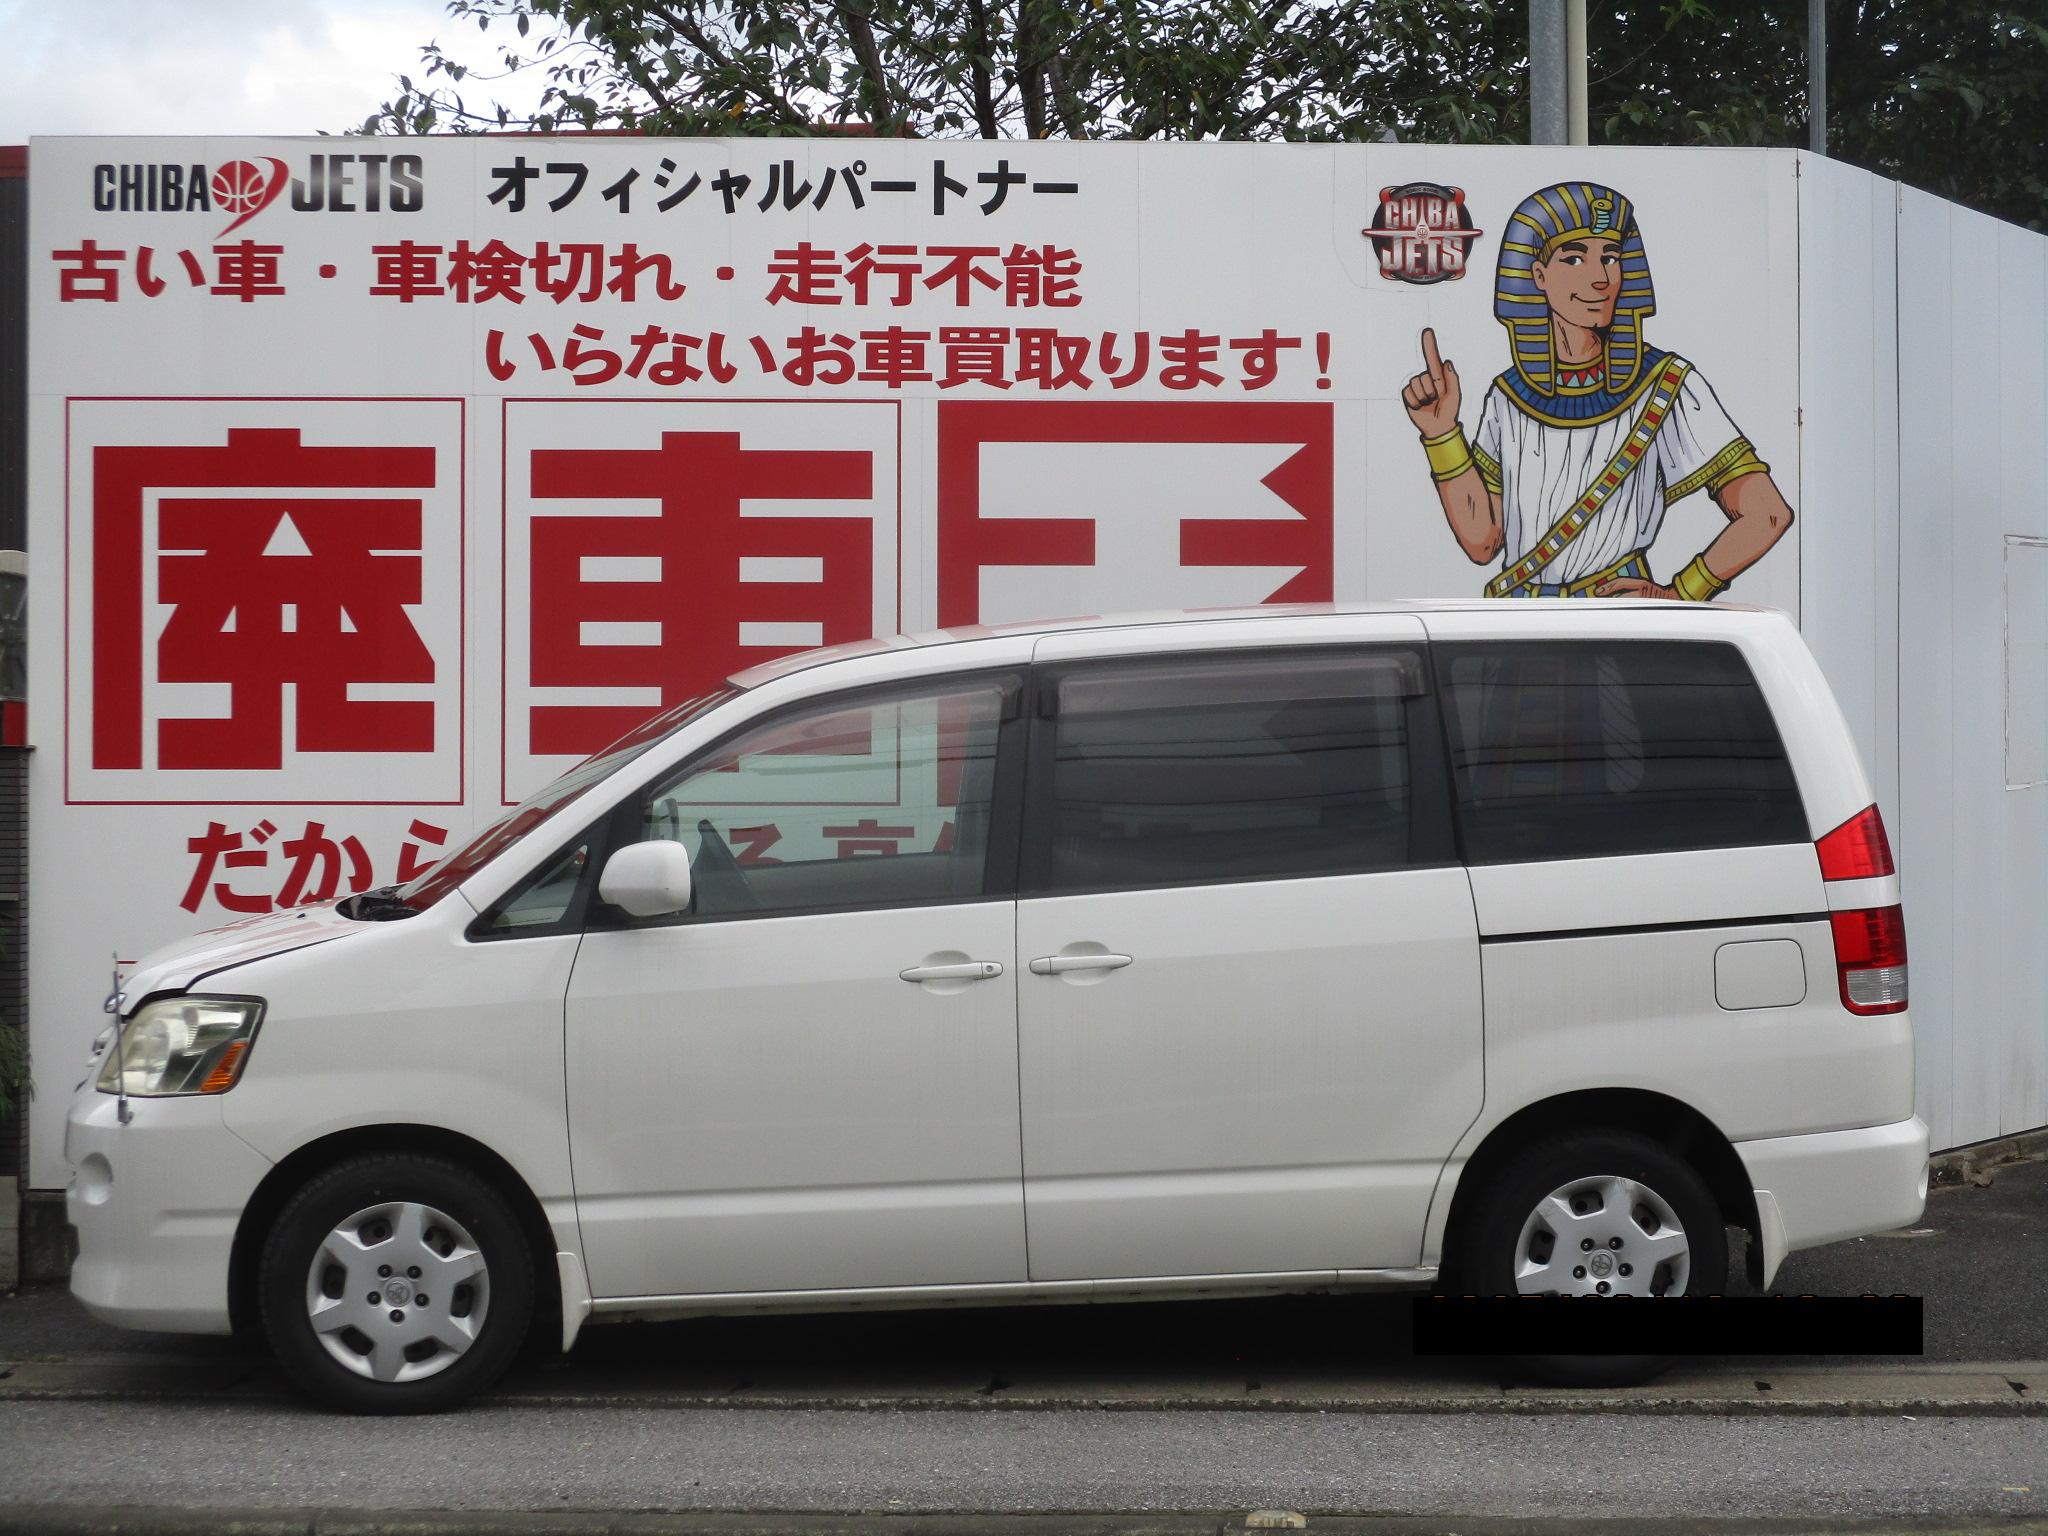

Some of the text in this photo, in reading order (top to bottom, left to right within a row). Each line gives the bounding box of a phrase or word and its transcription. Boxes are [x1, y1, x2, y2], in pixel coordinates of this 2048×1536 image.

[93, 154, 424, 213] CHIBA JETS
[487, 156, 1080, 215] オフィシャルパートナー
[1384, 199, 1460, 229] CHIBA
[1381, 236, 1464, 274] JETS
